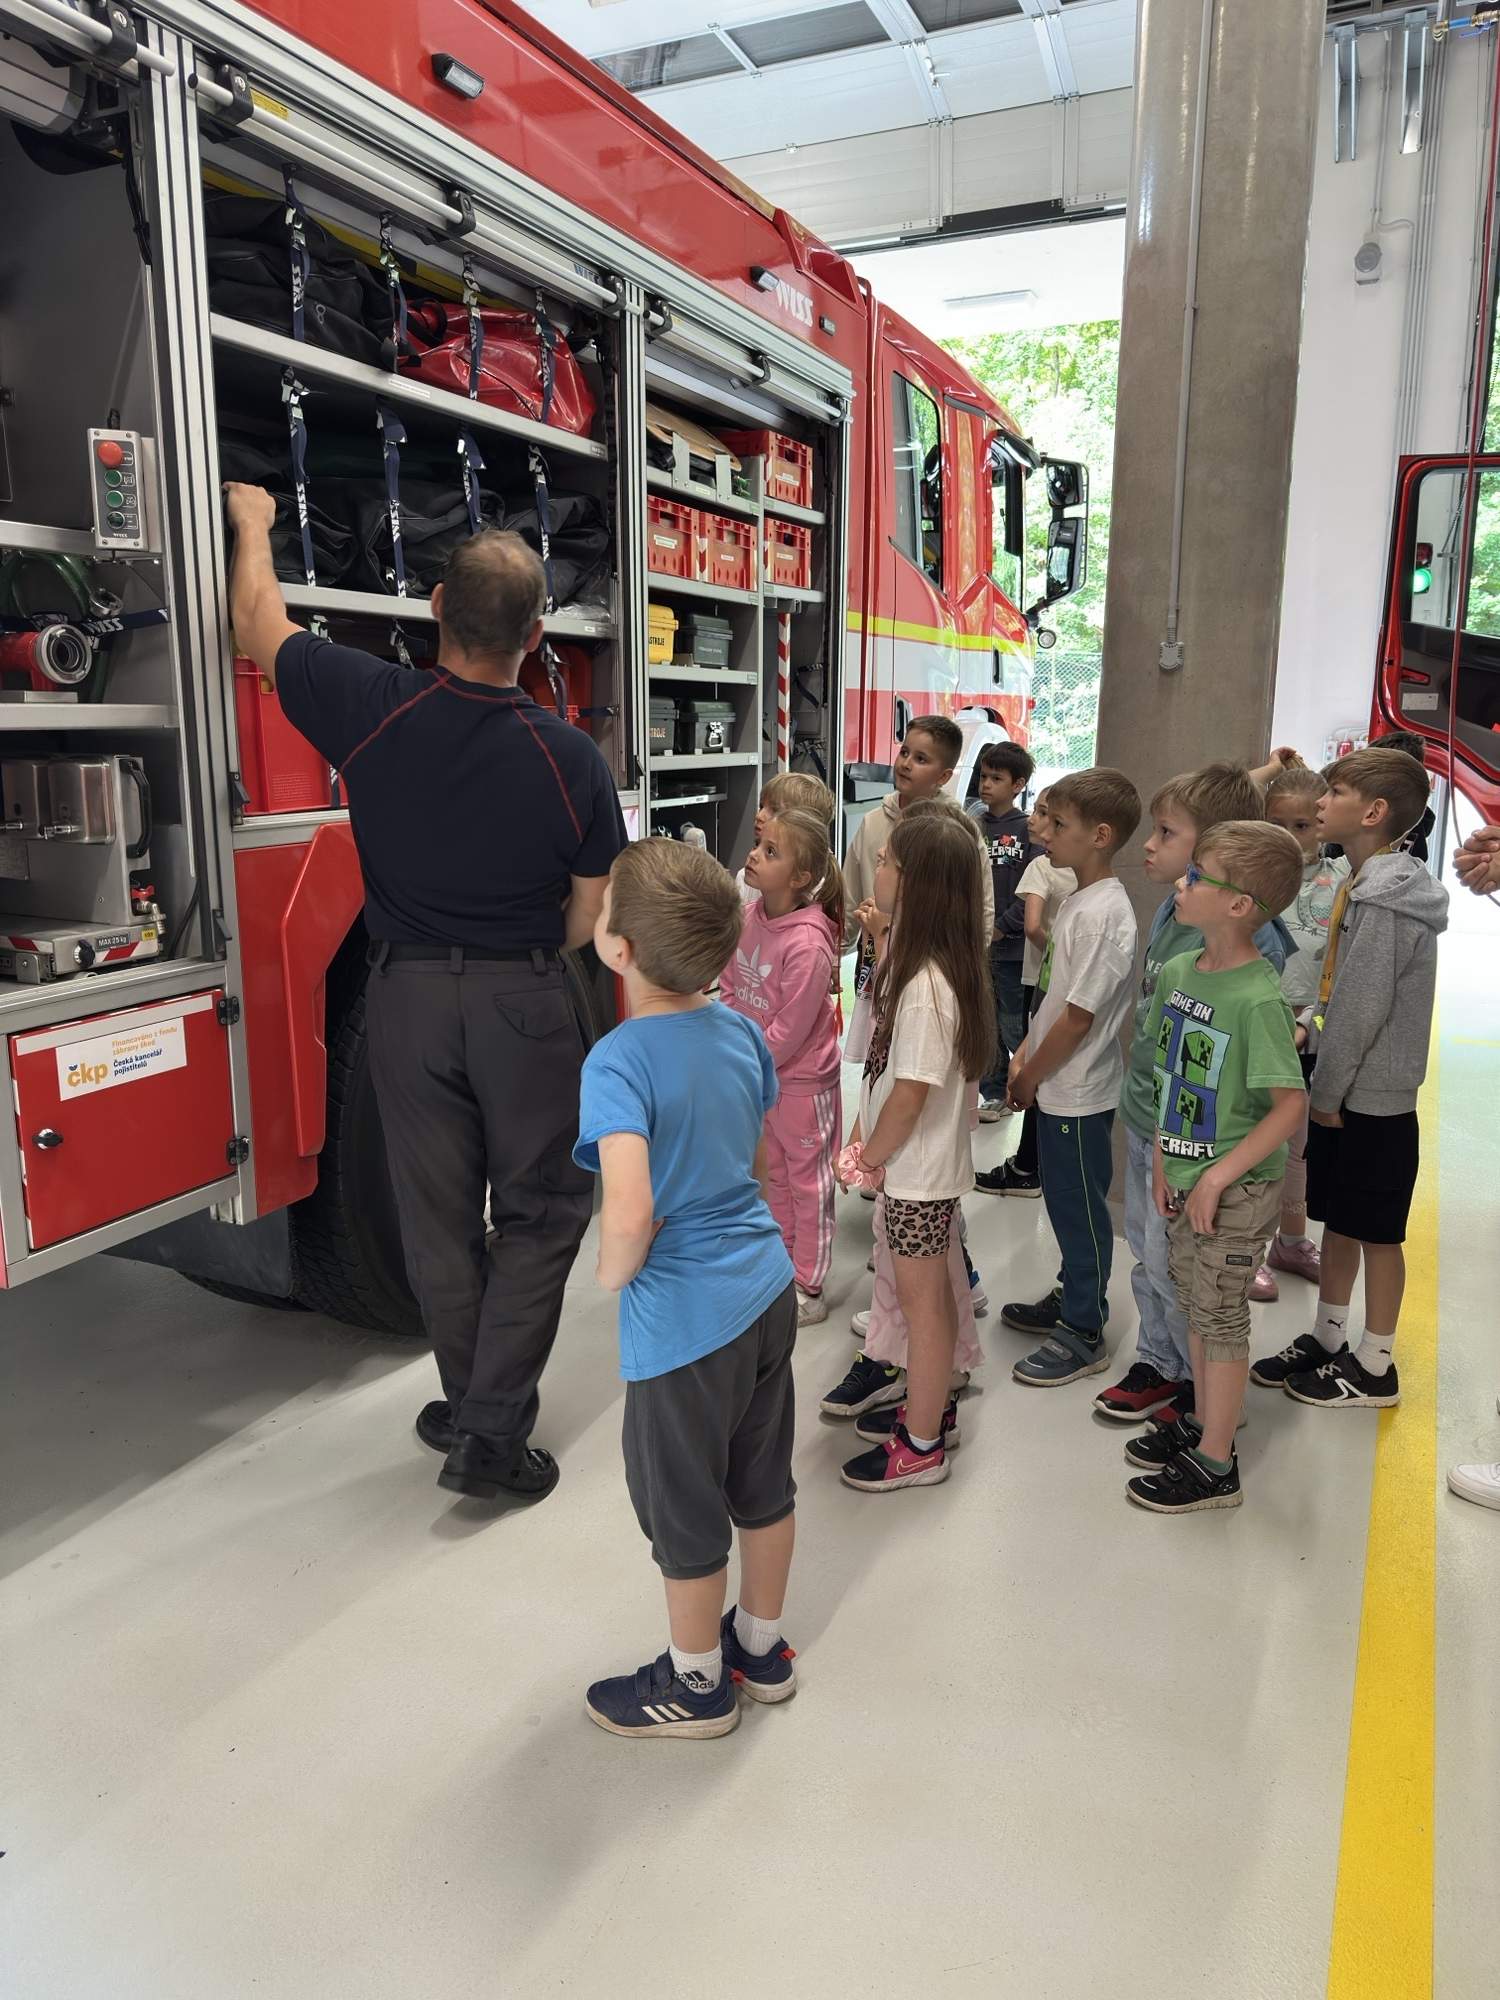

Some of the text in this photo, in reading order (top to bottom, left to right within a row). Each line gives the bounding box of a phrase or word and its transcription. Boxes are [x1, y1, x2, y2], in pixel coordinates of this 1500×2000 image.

[776, 279, 813, 327] WISS
[296, 482, 308, 528] WISS
[649, 636, 665, 646] STROJE
[988, 846, 1024, 859] ECRAFT
[1193, 1003, 1212, 1021] ON
[113, 1056, 134, 1067] Česká
[67, 1063, 108, 1087] čkp
[1160, 1135, 1215, 1158] CRAFT
